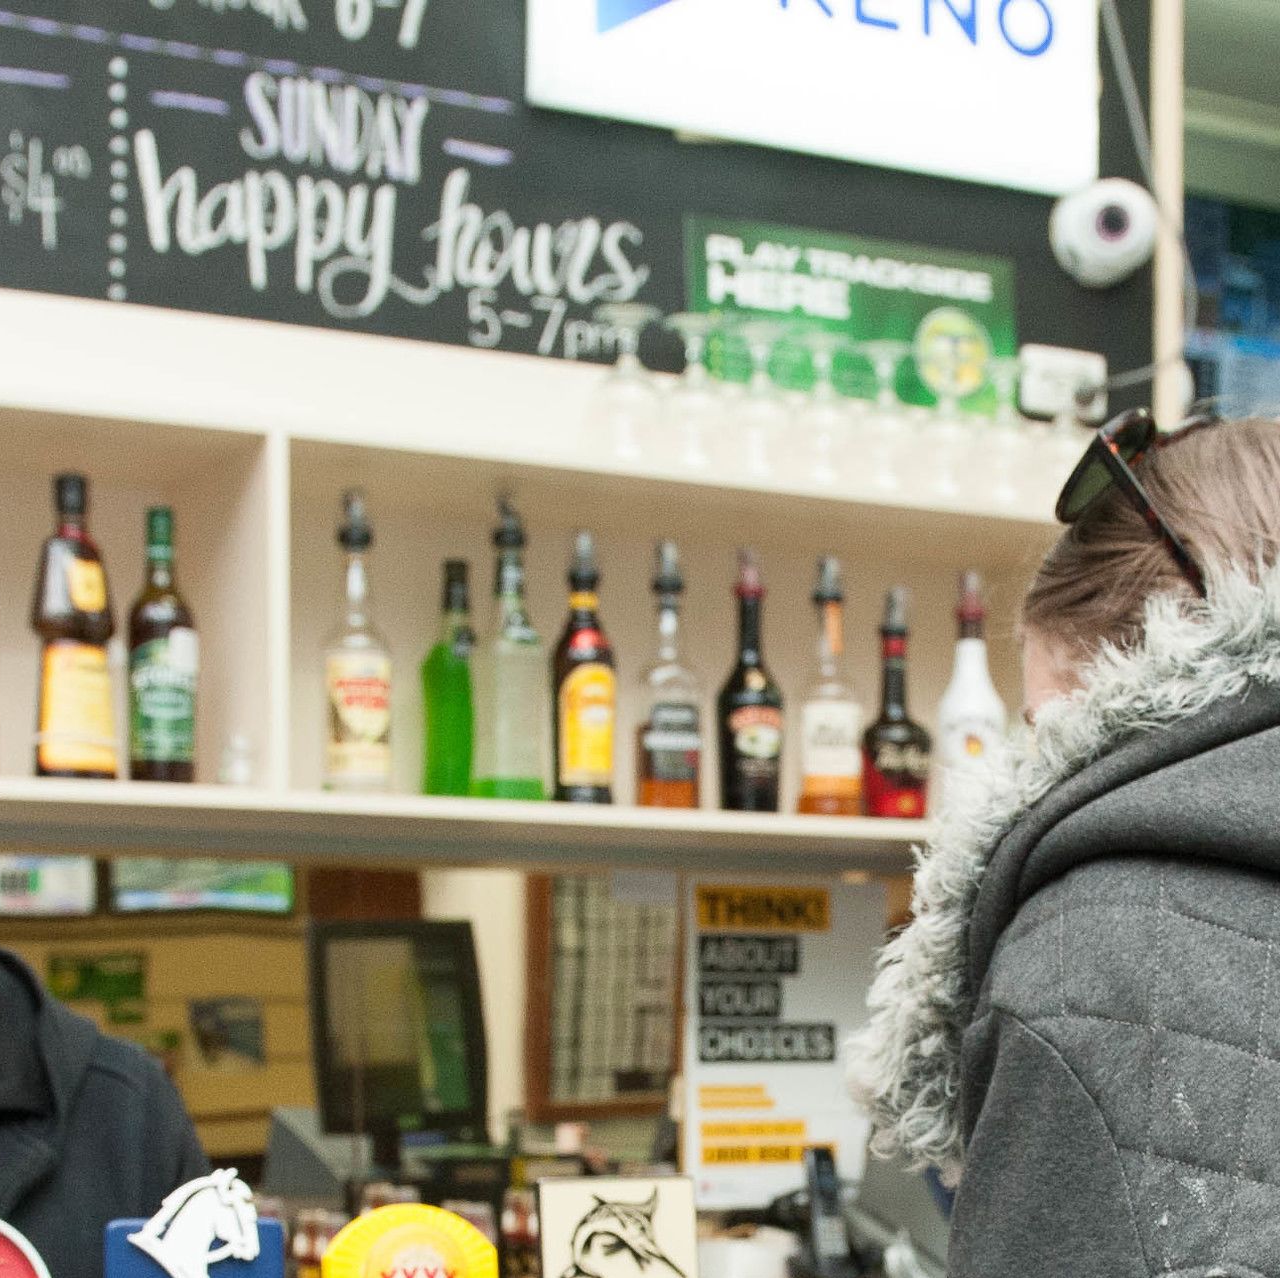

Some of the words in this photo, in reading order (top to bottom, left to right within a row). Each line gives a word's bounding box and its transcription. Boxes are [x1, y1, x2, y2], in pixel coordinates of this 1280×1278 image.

[778, 0, 1053, 57] NO
[238, 70, 428, 184] SUNDAY
[133, 128, 400, 318] happy
[418, 166, 648, 302] hours
[707, 262, 852, 321] HERE
[700, 938, 797, 972] ABOUT
[702, 983, 782, 1016] YOUR
[701, 1027, 836, 1062] CHOICES
